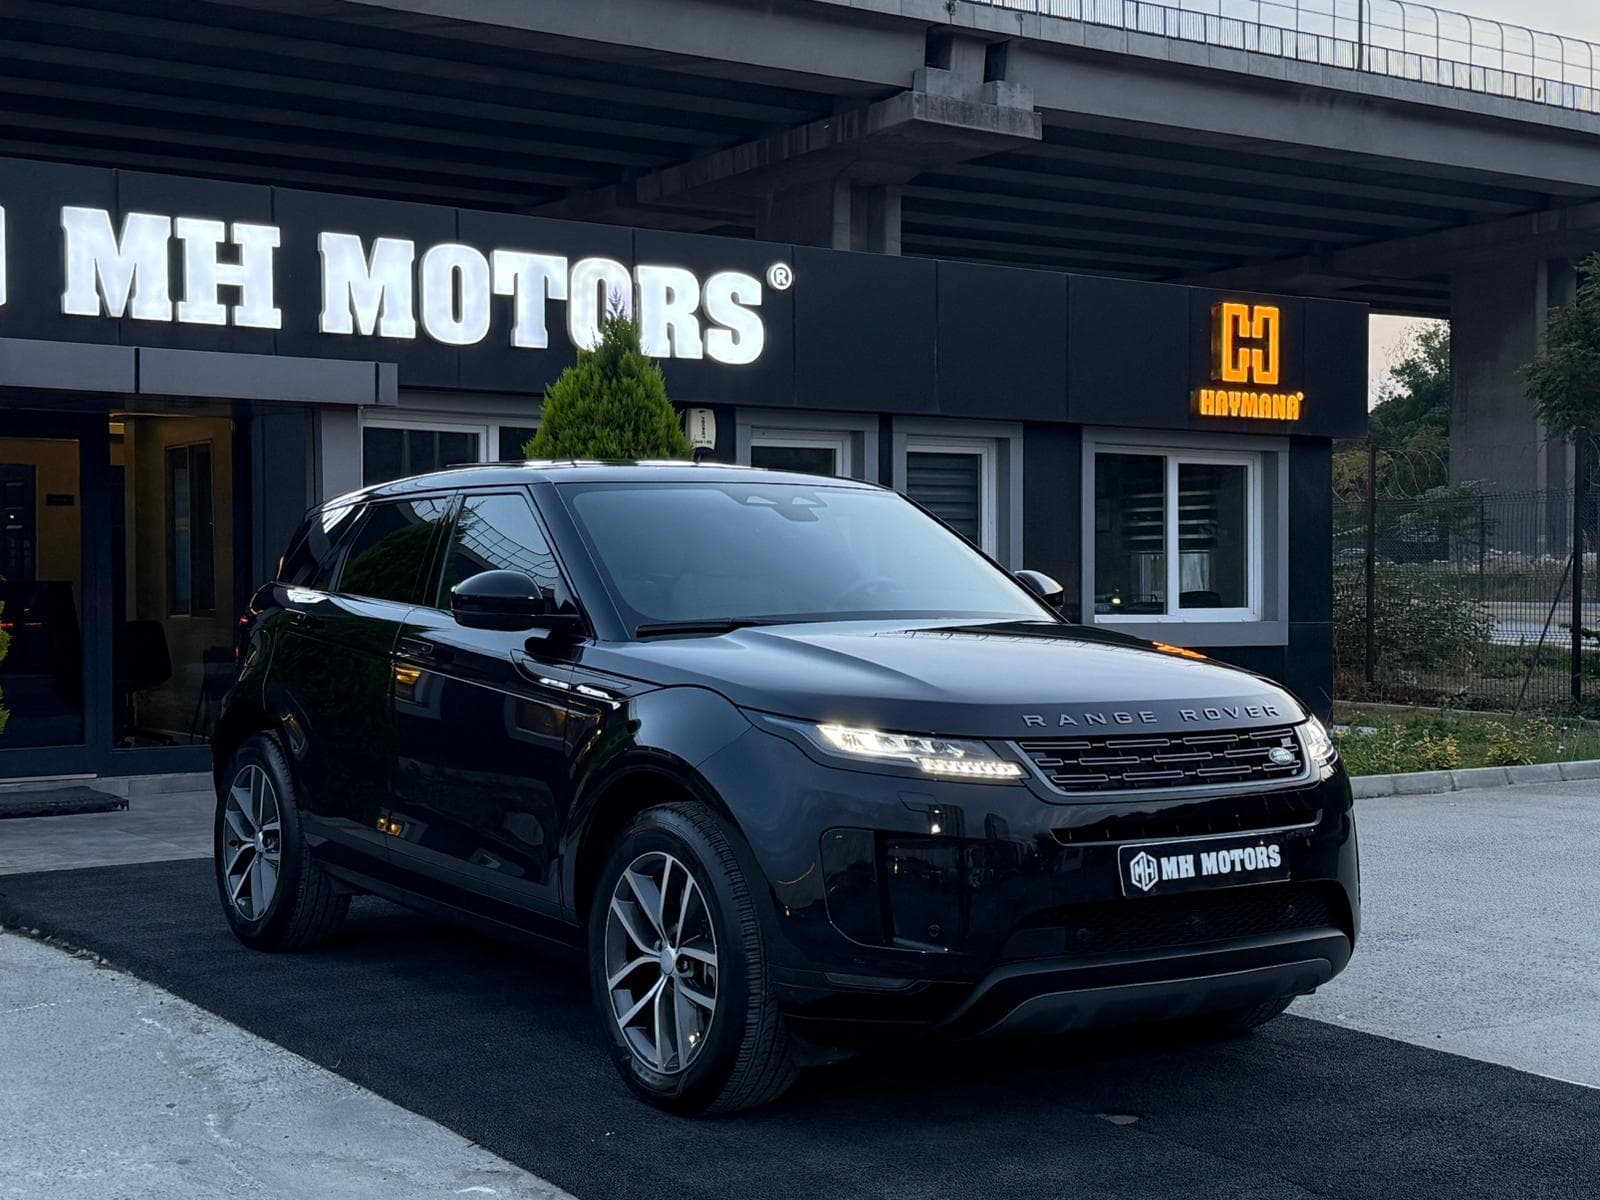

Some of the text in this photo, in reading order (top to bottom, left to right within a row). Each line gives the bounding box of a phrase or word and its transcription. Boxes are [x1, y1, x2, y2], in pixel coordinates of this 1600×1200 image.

[61, 205, 282, 330] MH
[1199, 388, 1300, 421] HAYMANA
[1021, 704, 1280, 728] RANGE ROVER
[1160, 844, 1282, 881] MH MOTORS
